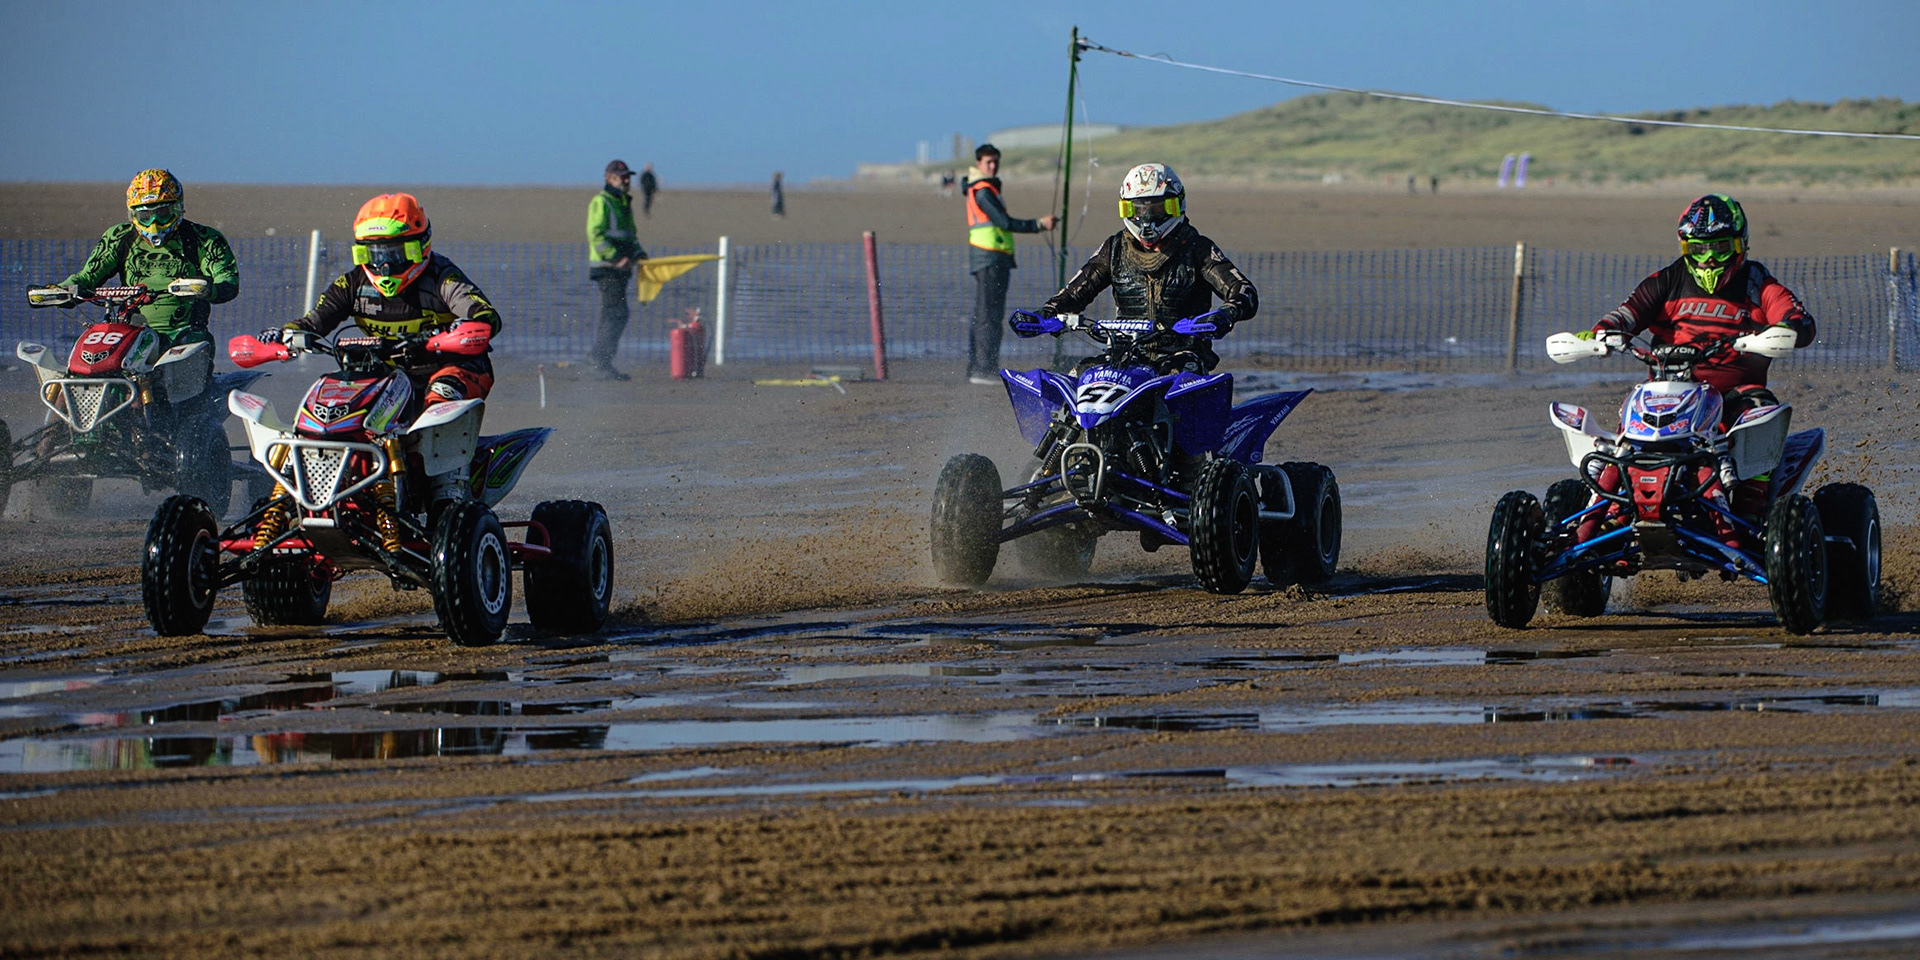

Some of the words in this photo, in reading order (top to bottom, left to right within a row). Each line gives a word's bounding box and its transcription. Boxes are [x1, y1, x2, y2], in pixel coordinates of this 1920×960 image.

[83, 331, 123, 345] 86
[1015, 373, 1034, 386] YAMAHA
[1094, 369, 1132, 386] YAMAHA
[1179, 377, 1206, 389] YAMAHA
[1077, 386, 1128, 404] 51
[1270, 404, 1290, 425] YAMAHA
